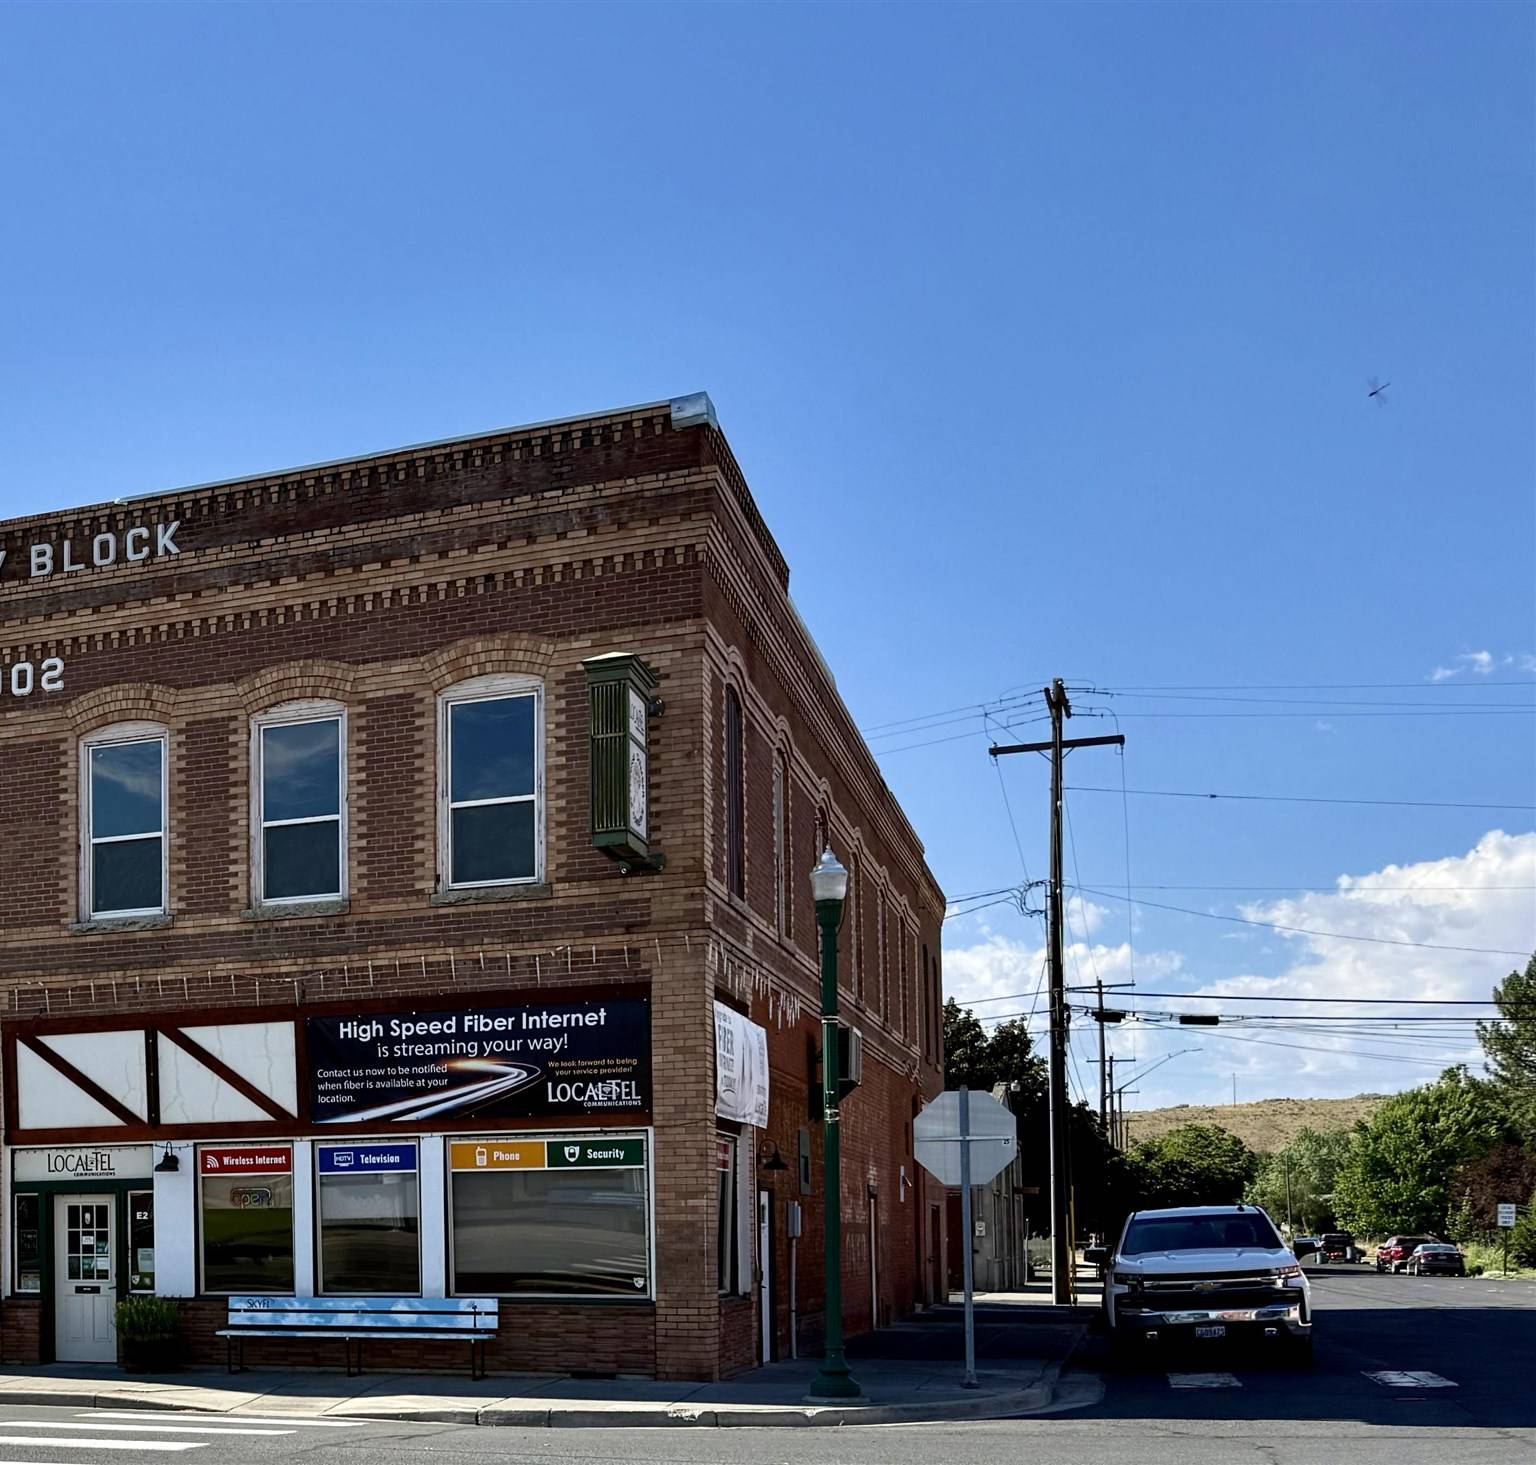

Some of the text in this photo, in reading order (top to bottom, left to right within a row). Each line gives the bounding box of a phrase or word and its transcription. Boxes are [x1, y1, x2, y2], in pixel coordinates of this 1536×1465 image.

[30, 520, 181, 577] BLOCK
[339, 1008, 607, 1042] High Speed Fiber Internet
[377, 1033, 568, 1058] is streaming your way!
[577, 1059, 605, 1067] forward
[616, 1058, 638, 1066] being
[317, 1063, 448, 1078] Contact us now to be notified
[599, 1066, 633, 1075] provider!
[317, 1078, 448, 1091] when fiber is available at your
[317, 1094, 356, 1104] location.
[222, 1154, 286, 1166] Wireless Internet
[360, 1153, 400, 1164] Television
[493, 1151, 520, 1161] Phone
[587, 1148, 625, 1160] Security
[136, 1211, 149, 1220] E2
